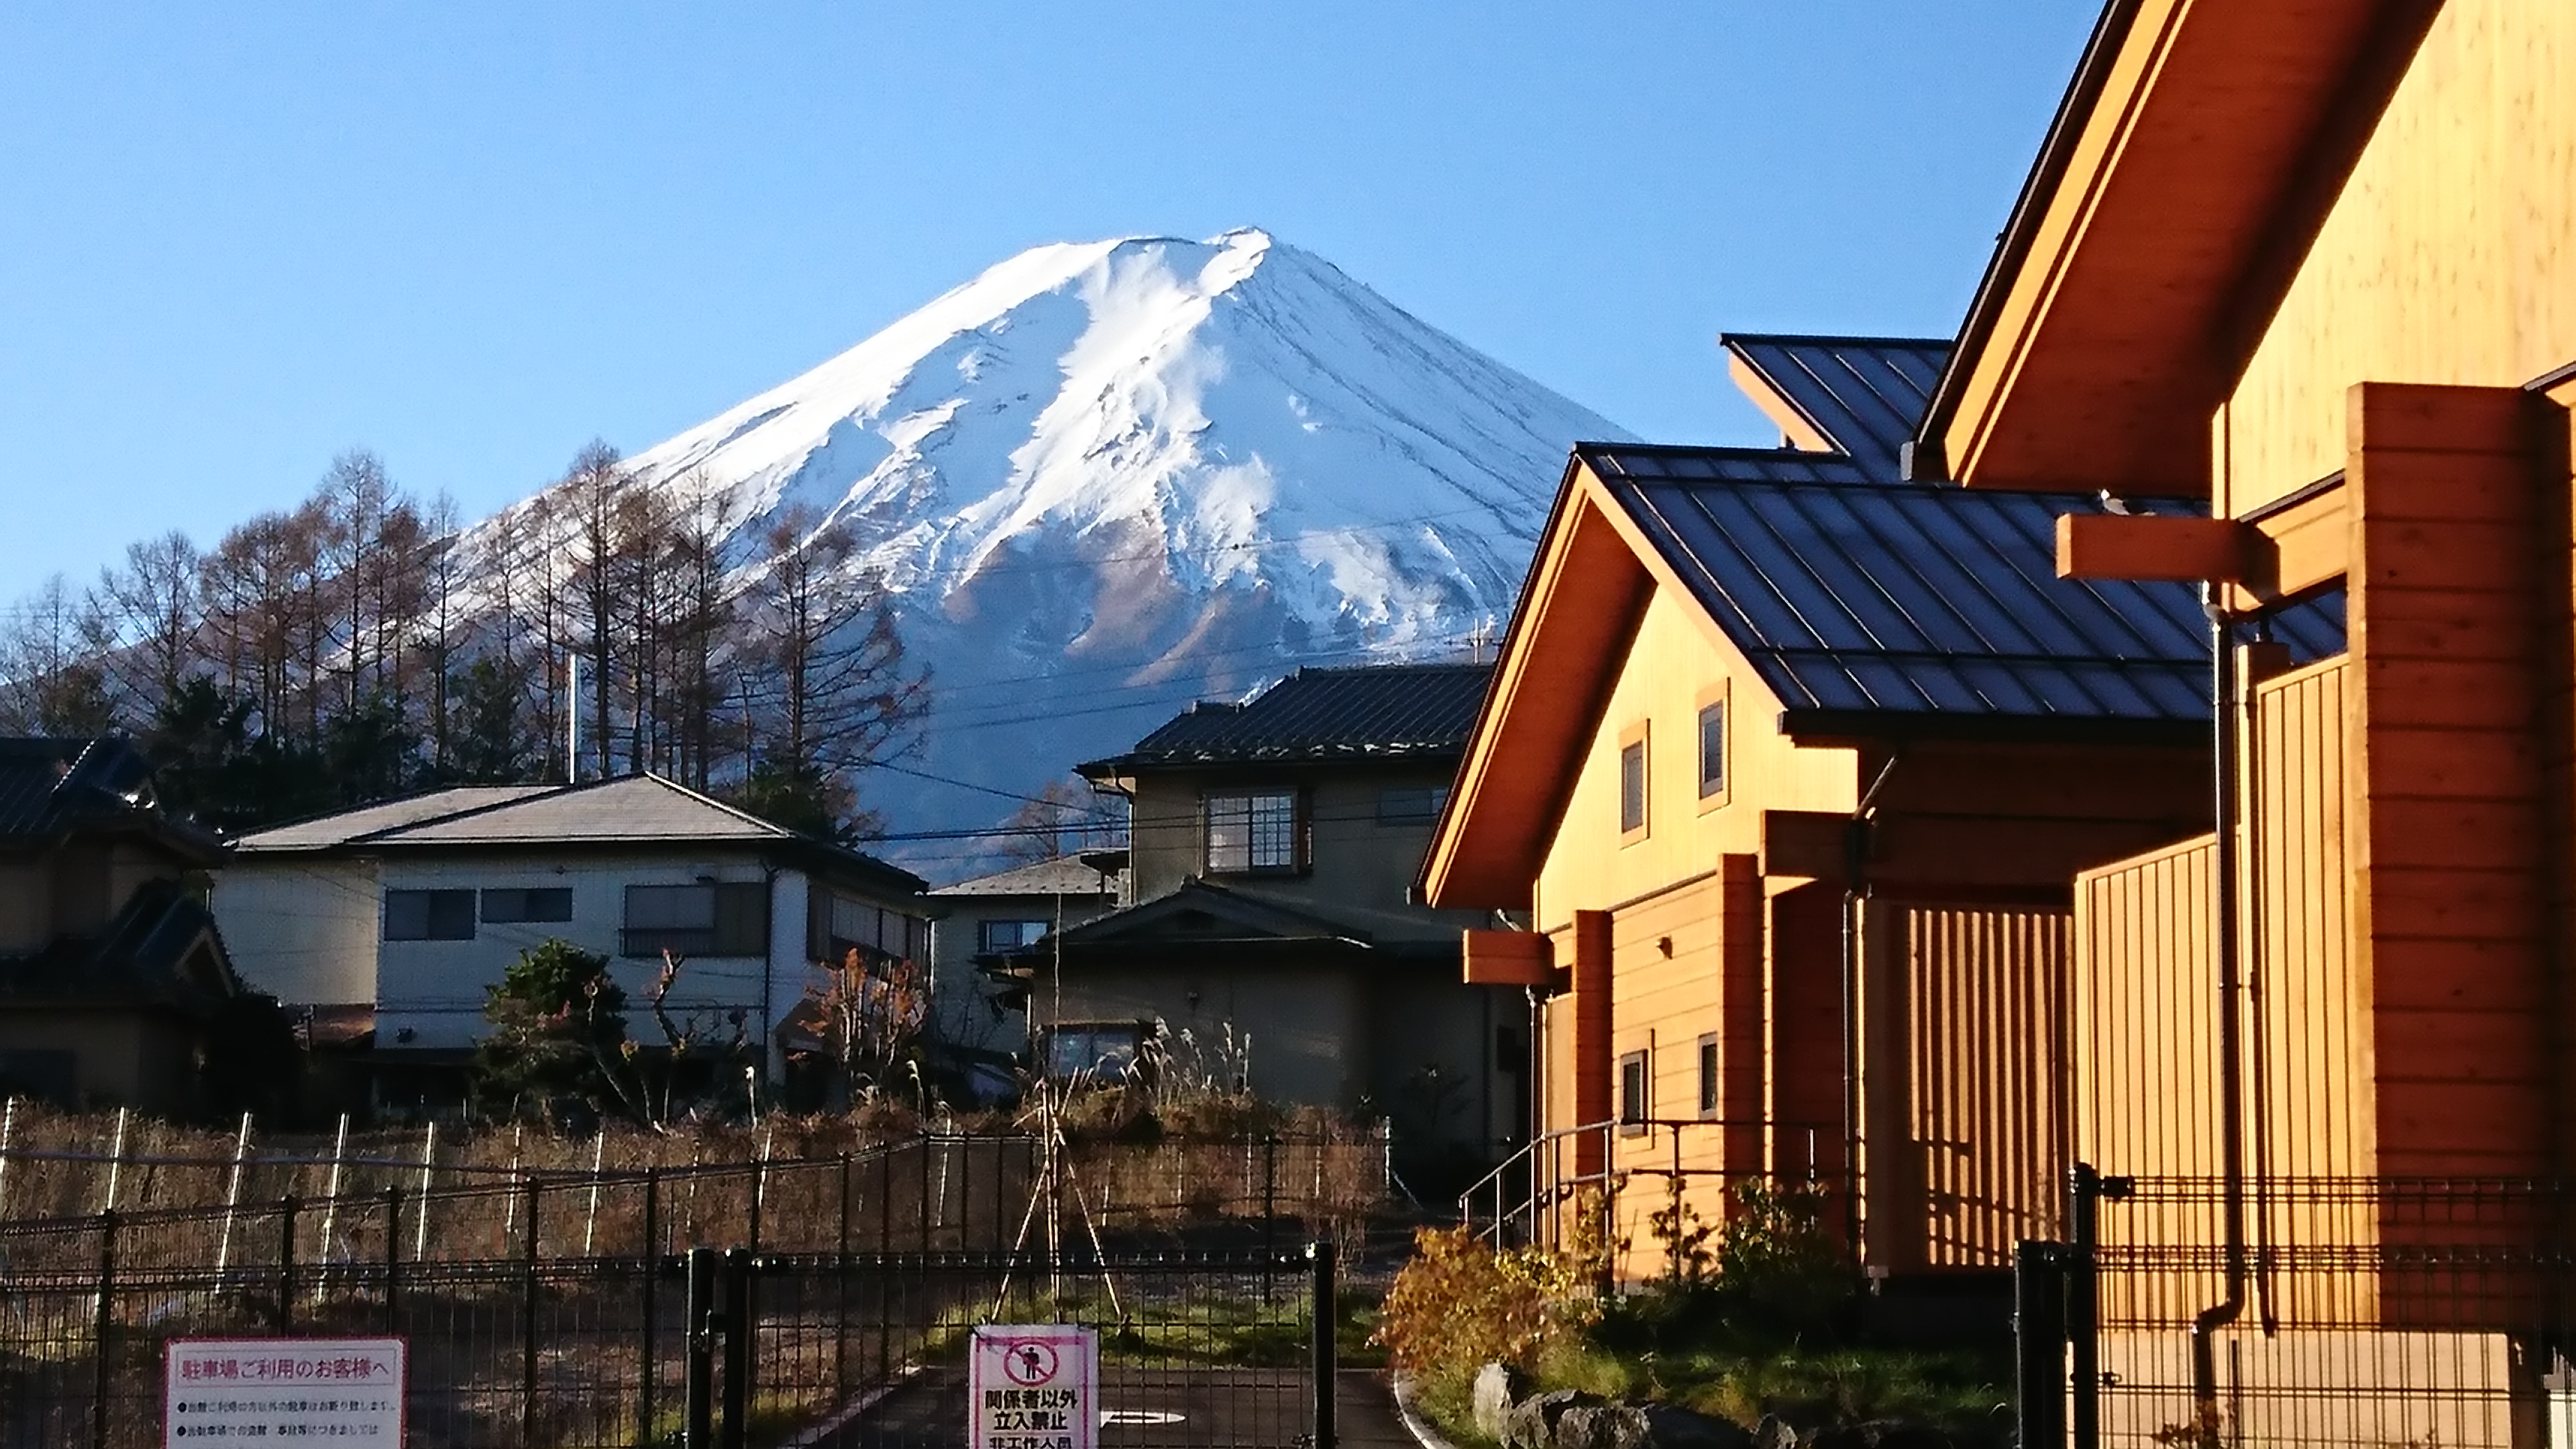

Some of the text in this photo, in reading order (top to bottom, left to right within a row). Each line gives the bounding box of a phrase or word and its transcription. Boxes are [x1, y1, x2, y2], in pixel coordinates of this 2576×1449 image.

[182, 1358, 389, 1380] 駐車場ご利用のお客様へ
[985, 1389, 1078, 1409] 関係者以外
[994, 1411, 1069, 1431] 立入禁止
